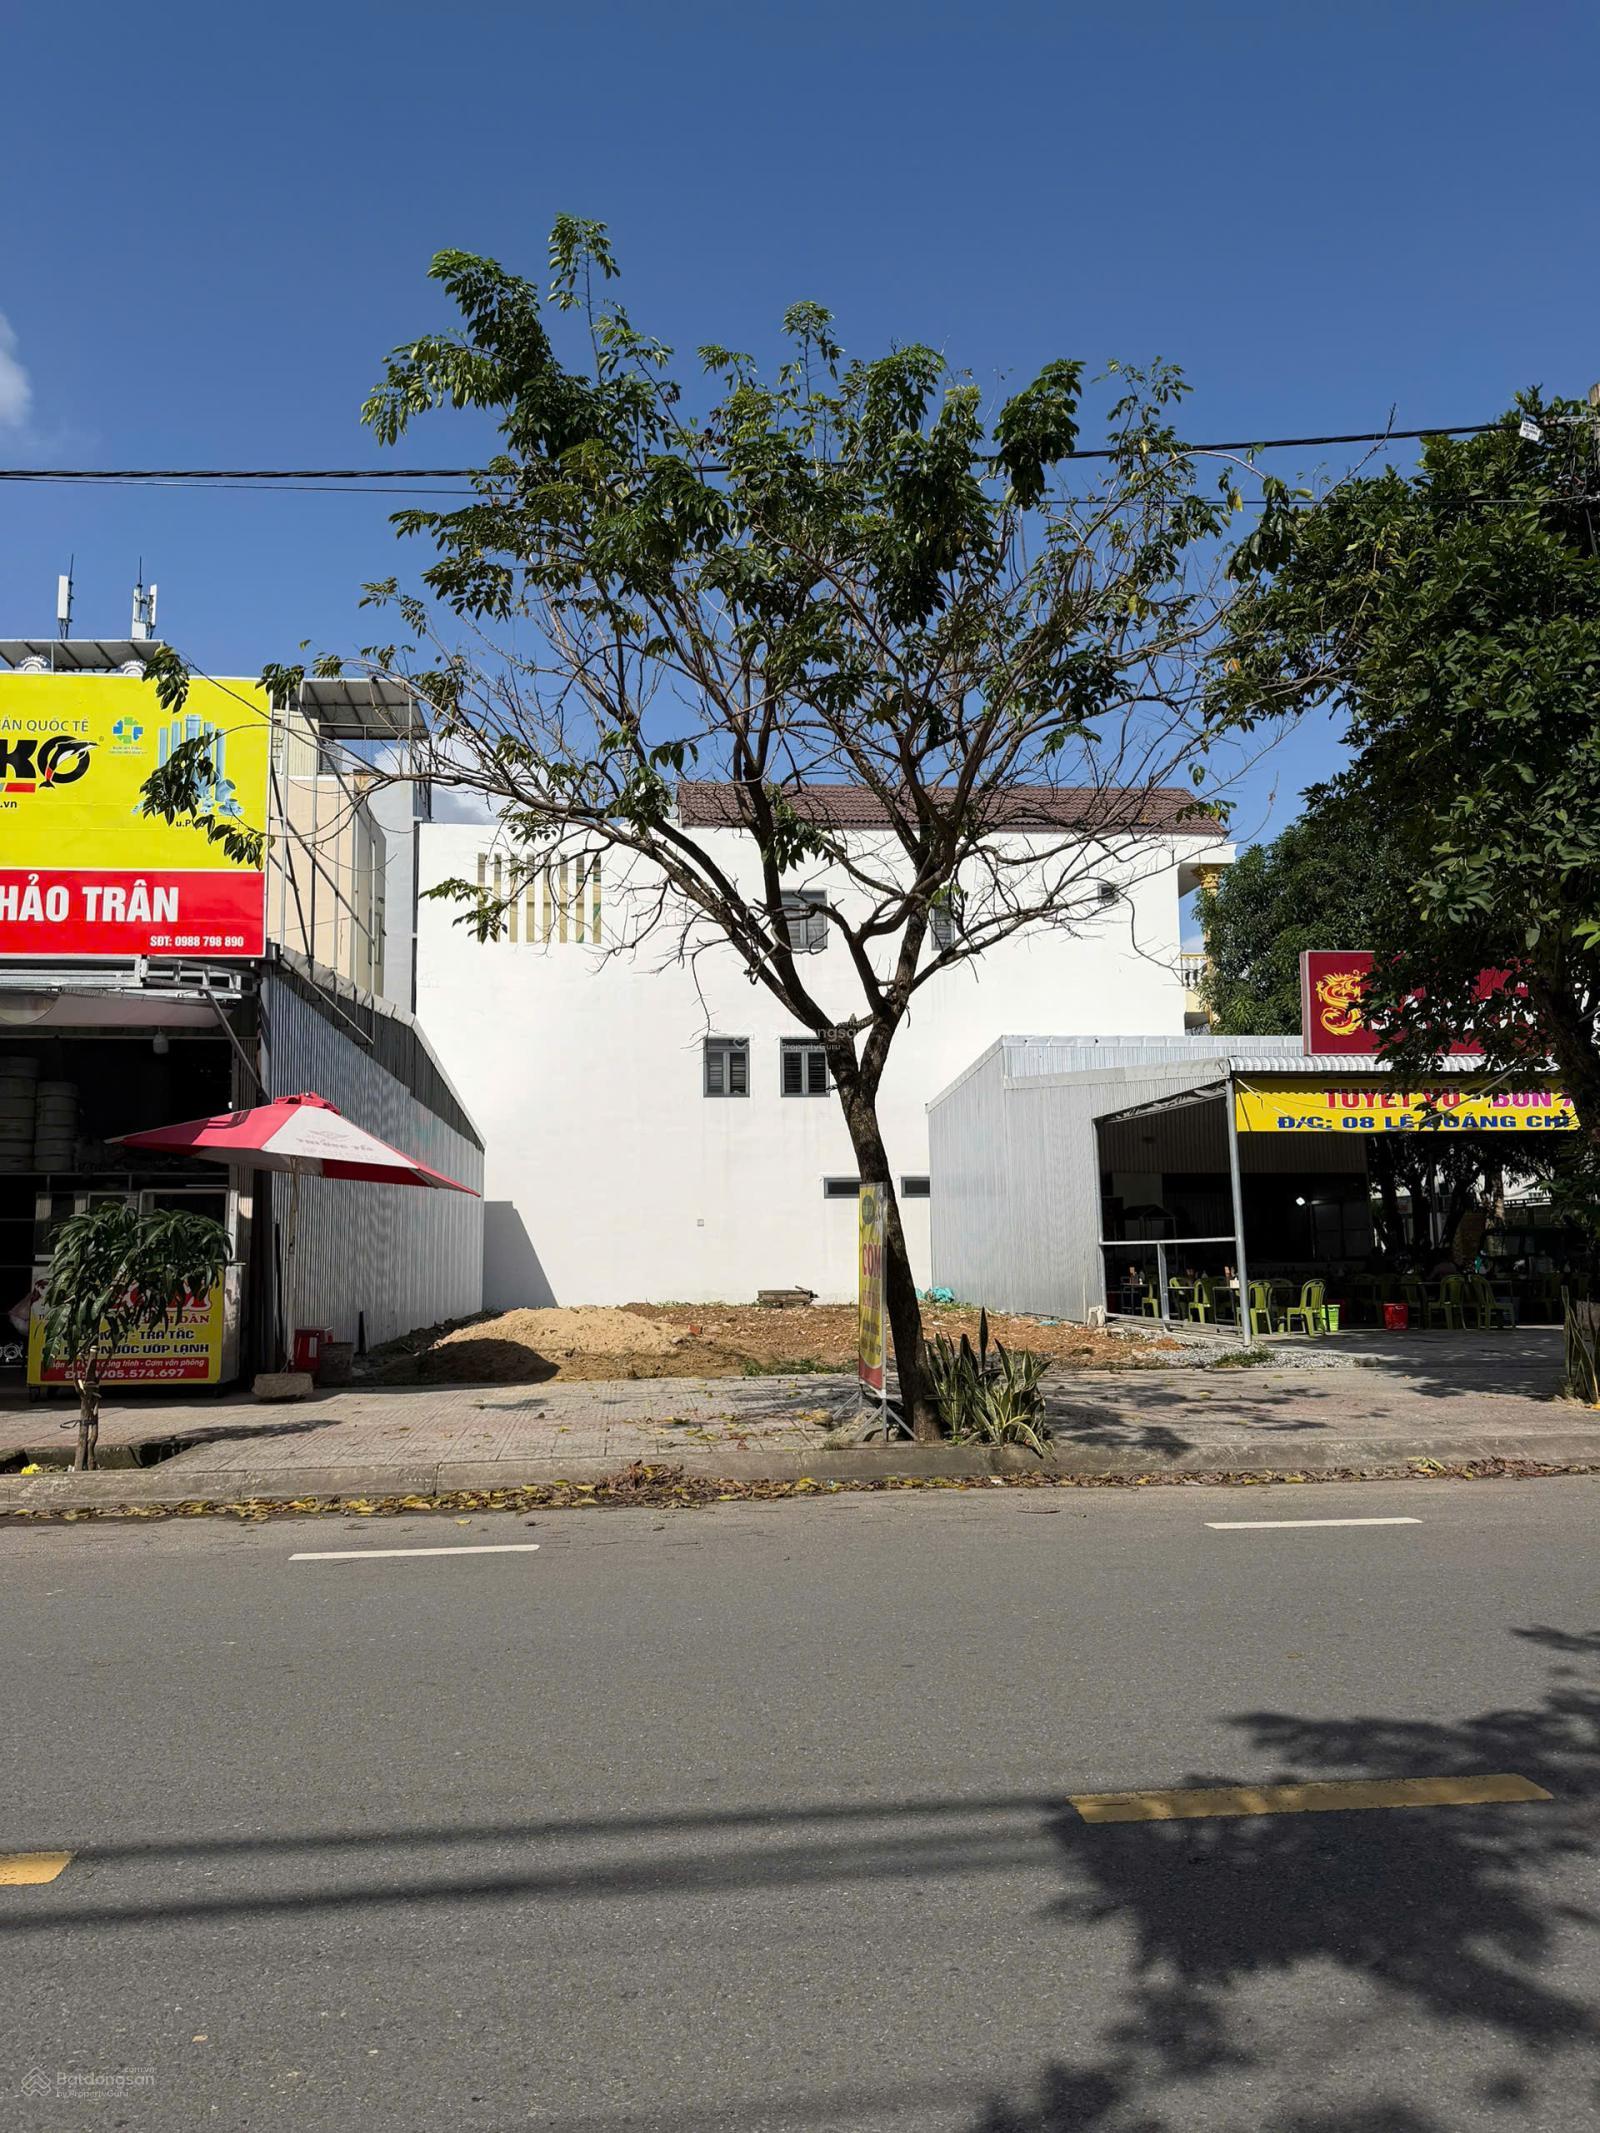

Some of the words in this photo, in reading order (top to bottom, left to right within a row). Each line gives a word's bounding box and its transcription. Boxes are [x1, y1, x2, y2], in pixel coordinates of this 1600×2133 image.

[26, 716, 69, 732] QUỐC
[72, 717, 89, 732] TẾ
[0, 873, 70, 923] HẢO
[82, 879, 179, 923] TRÂN
[150, 935, 173, 947] SĐT:
[174, 935, 201, 947] 0988
[203, 935, 222, 947] 798
[224, 935, 244, 947] 890
[1277, 1115, 1333, 1129] Đ/C:
[1342, 1115, 1375, 1129] 08
[1385, 1113, 1415, 1129] LÊ
[1424, 1111, 1516, 1128] UẢNG
[173, 1343, 209, 1355] LẠNH
[92, 1369, 185, 1379] 05.574.697
